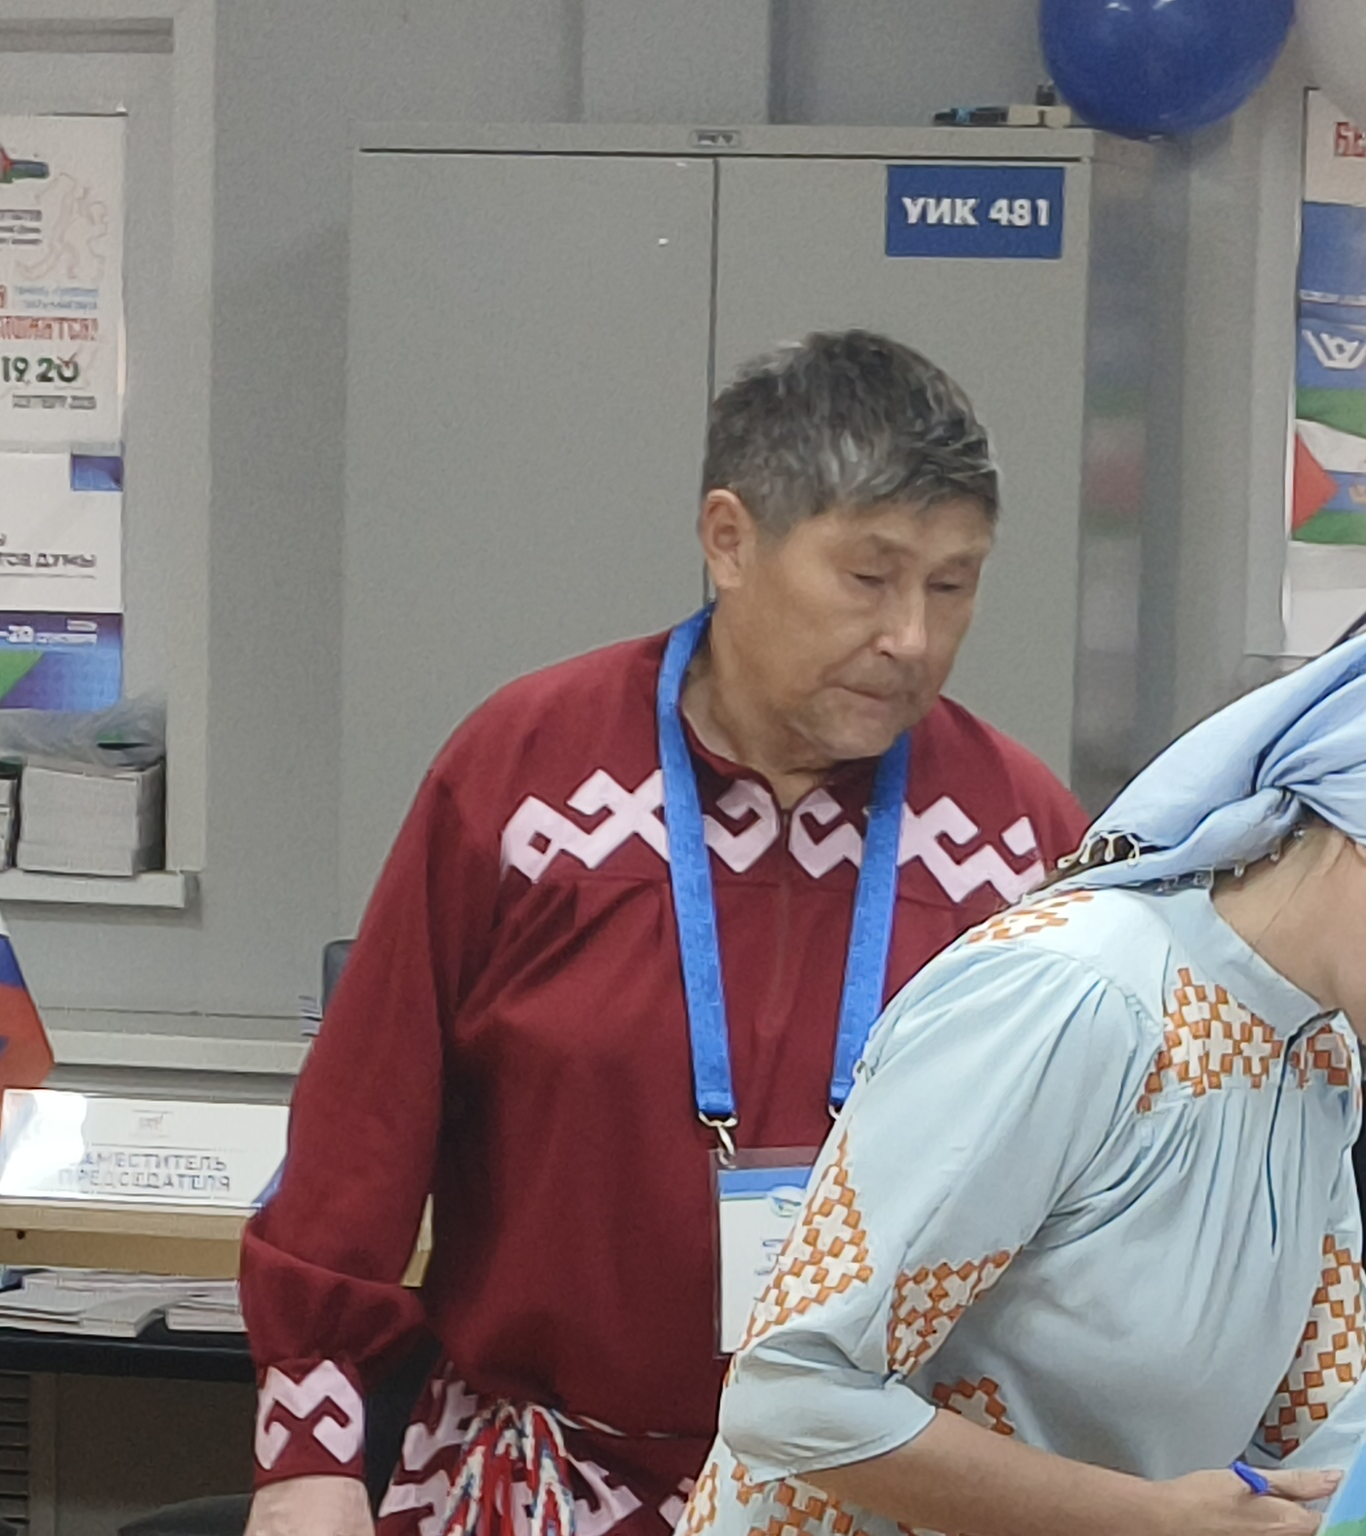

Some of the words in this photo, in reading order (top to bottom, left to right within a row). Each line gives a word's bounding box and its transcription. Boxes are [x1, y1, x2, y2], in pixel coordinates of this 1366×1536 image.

[902, 197, 978, 225] УИК
[988, 198, 1049, 226] 481
[83, 1151, 228, 1171] АМЕСТИТЕЛЬ
